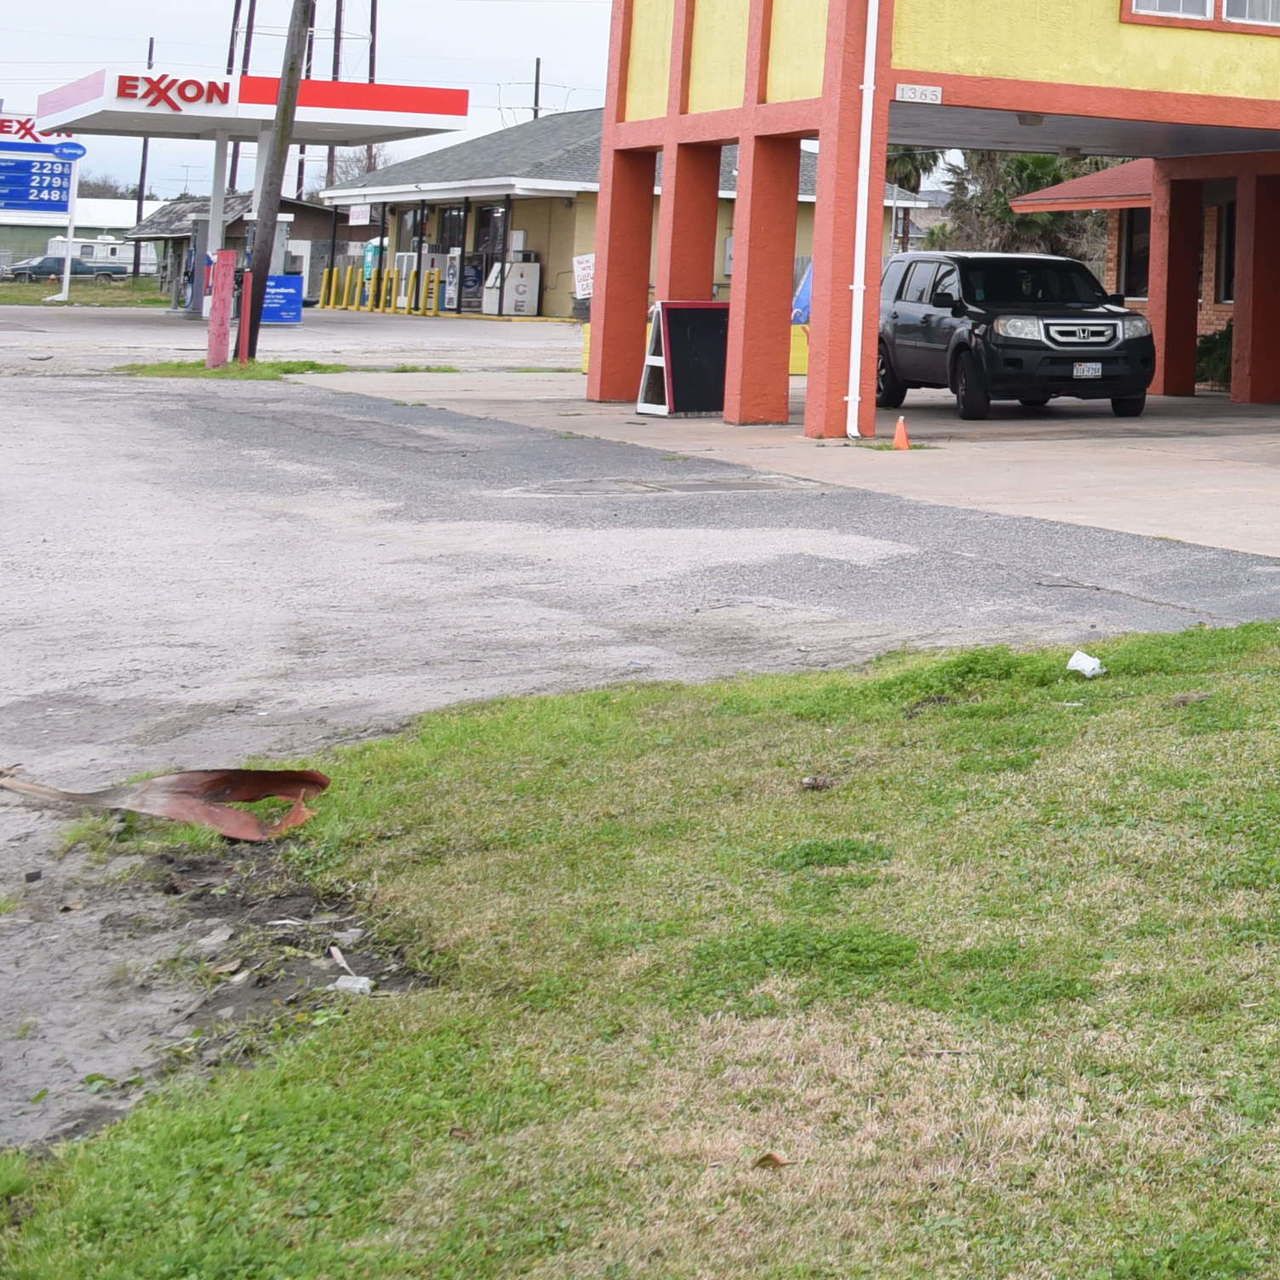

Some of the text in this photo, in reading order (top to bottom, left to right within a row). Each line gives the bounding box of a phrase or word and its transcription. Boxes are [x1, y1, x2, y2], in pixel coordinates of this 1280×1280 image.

[117, 74, 230, 111] EXXON
[0, 118, 73, 142] EXX
[31, 162, 63, 174] 229
[30, 175, 62, 187] 279
[28, 189, 61, 201] 248
